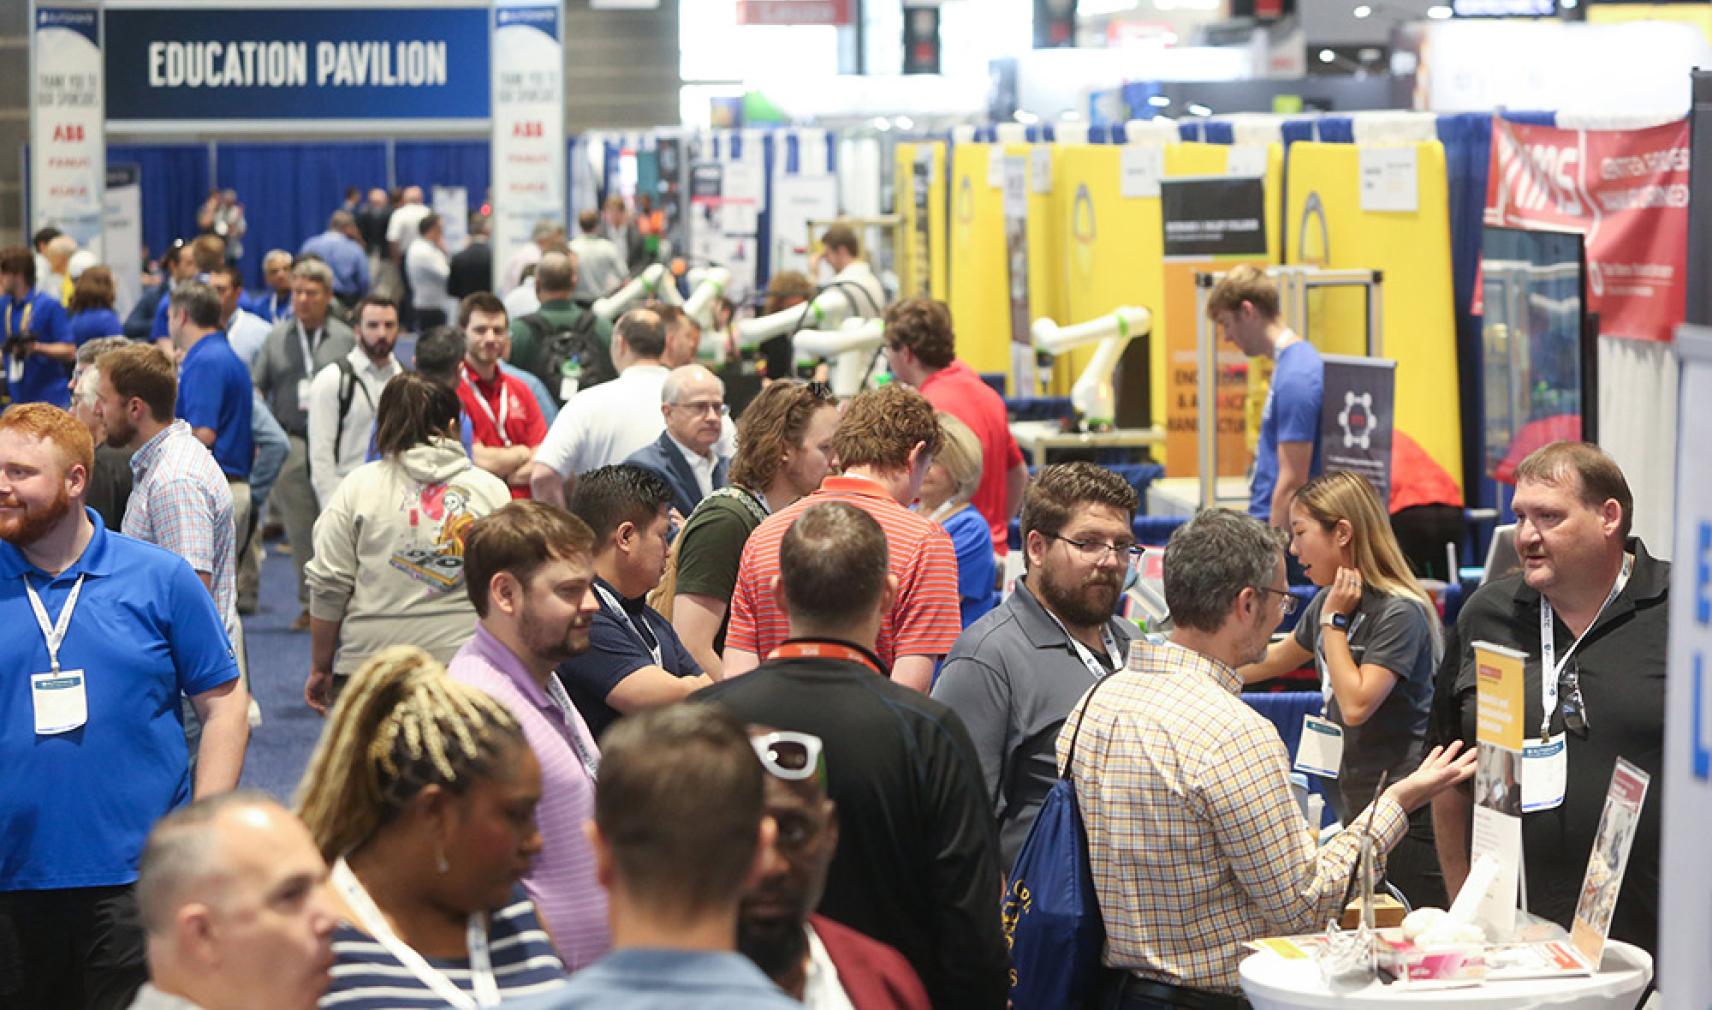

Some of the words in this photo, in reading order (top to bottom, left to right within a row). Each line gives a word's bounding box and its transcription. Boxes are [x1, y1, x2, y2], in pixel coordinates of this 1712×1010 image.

[149, 40, 307, 87] EDUCATION
[316, 41, 447, 87] PAVILION
[53, 124, 85, 142] ABB
[512, 121, 544, 138] ABB
